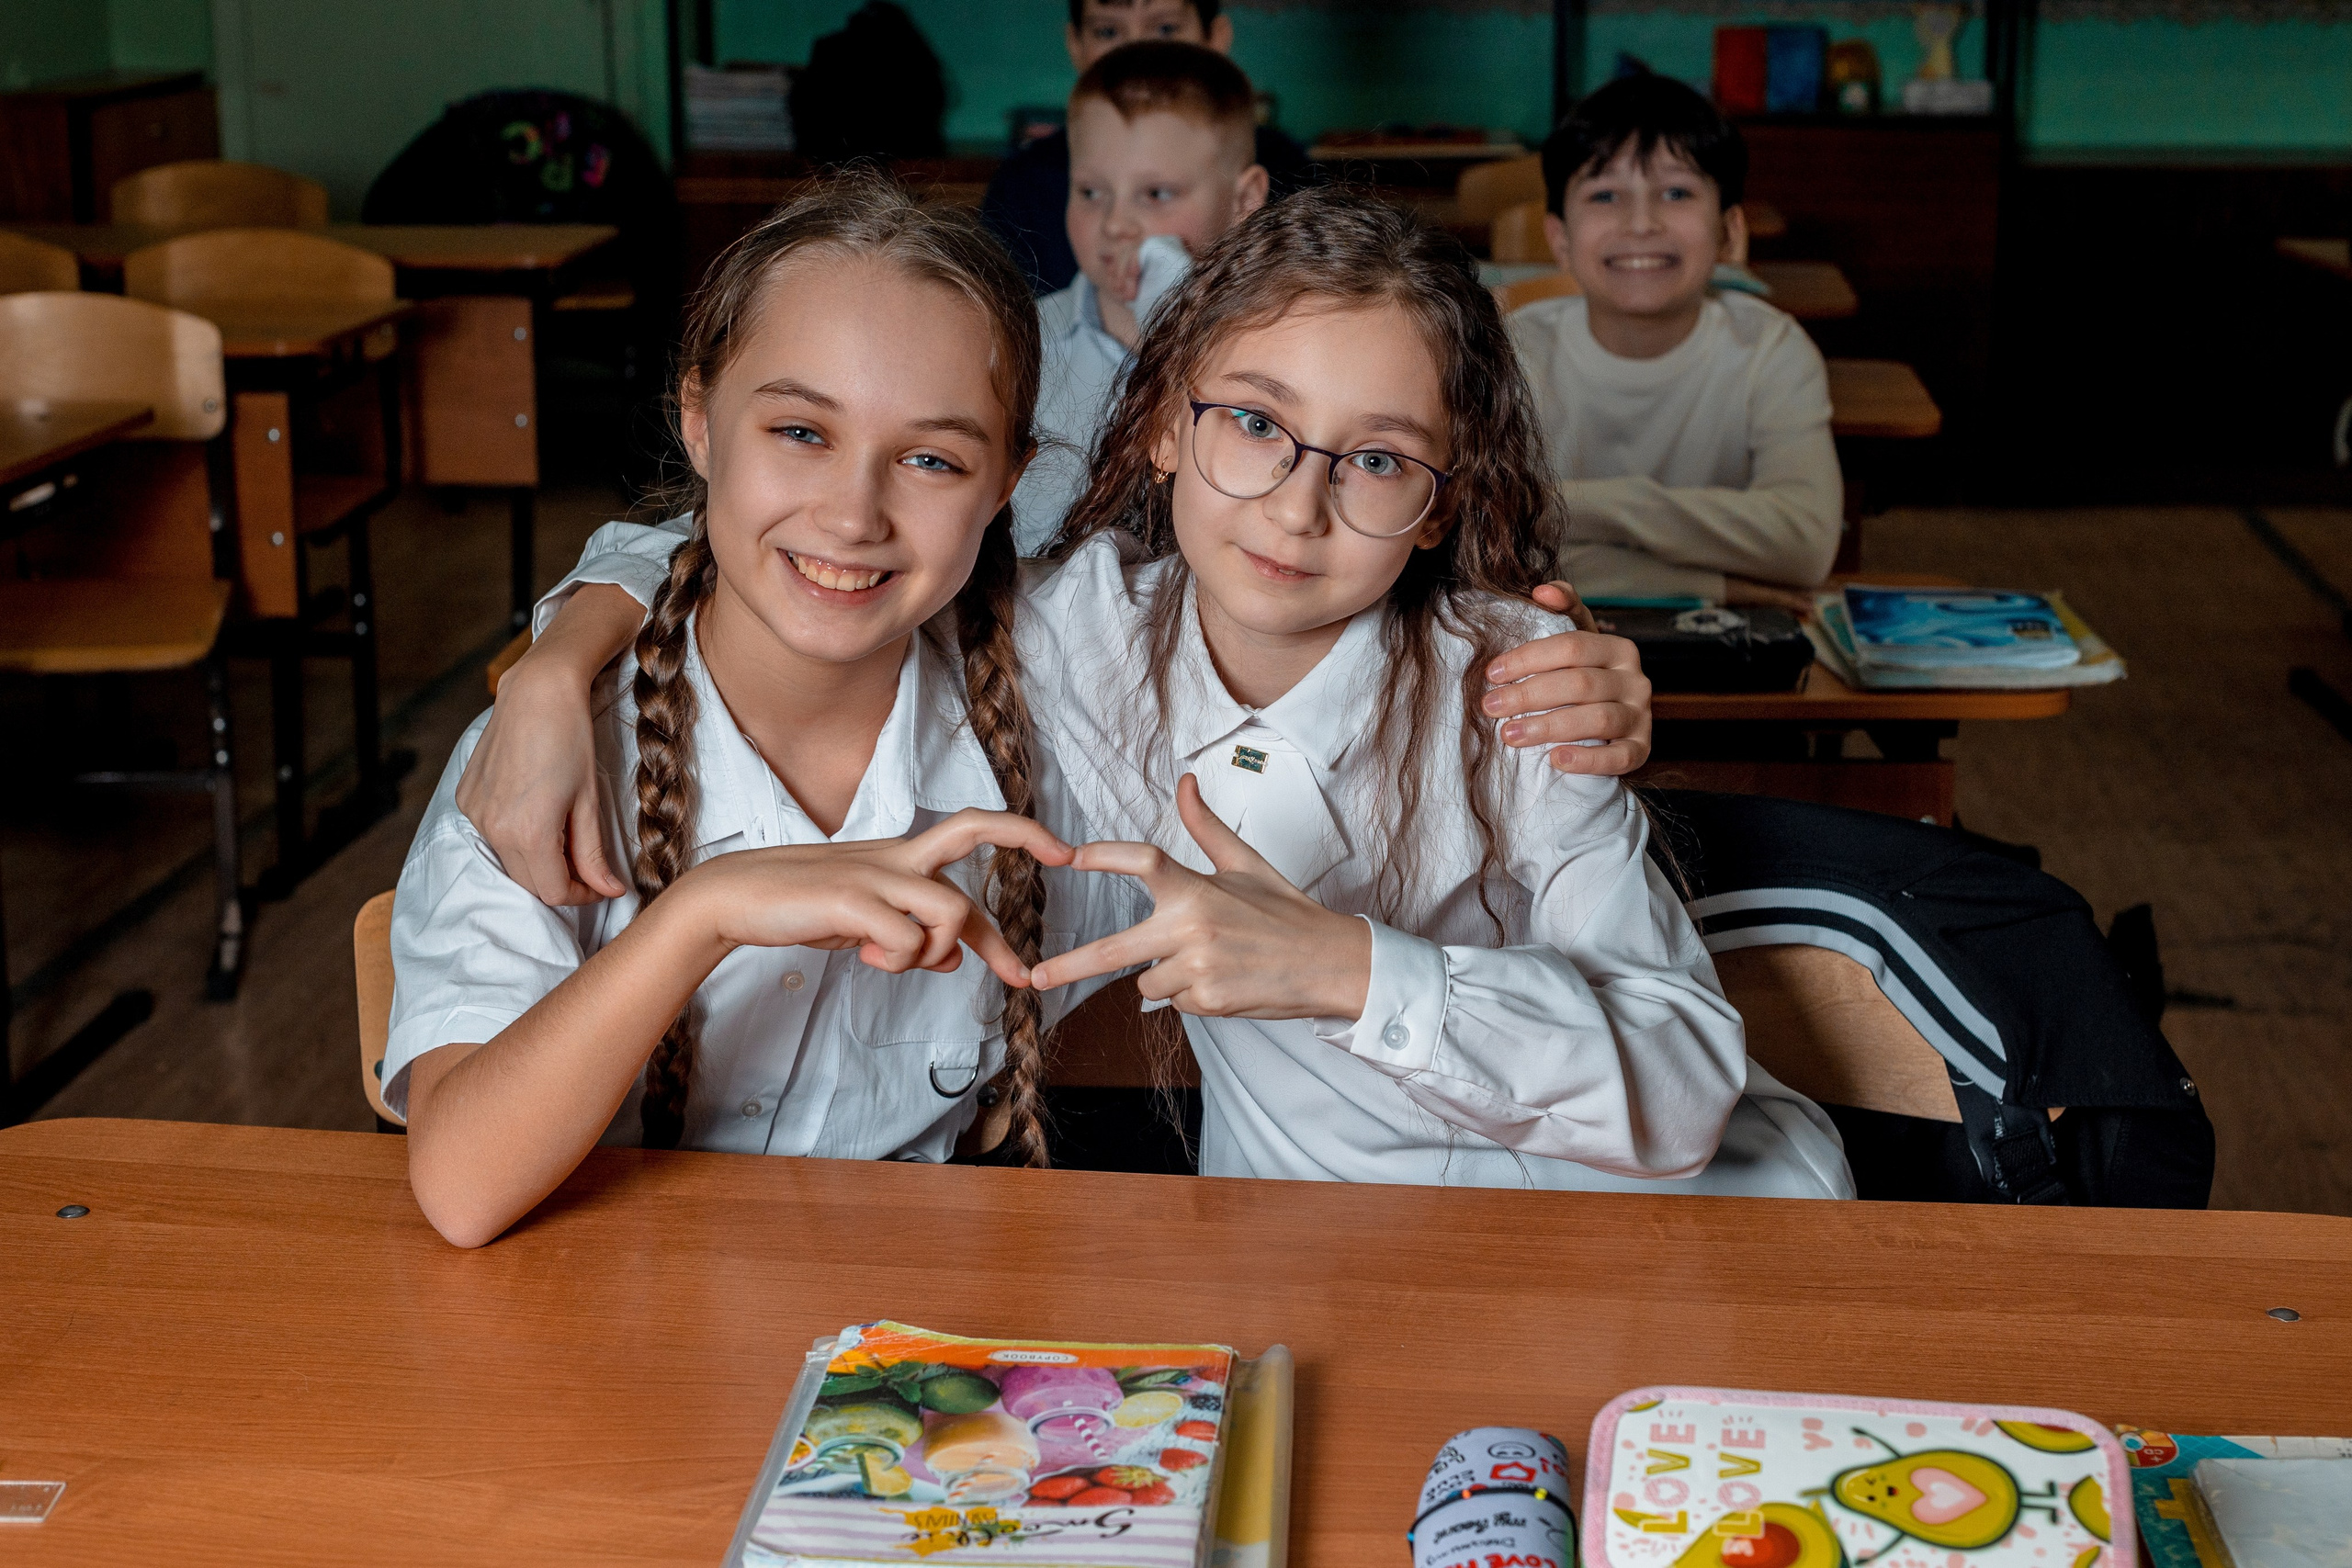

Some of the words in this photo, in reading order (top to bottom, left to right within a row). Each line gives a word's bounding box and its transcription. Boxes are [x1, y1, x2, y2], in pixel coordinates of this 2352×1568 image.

[1002, 1353, 1069, 1361] COPYBOOK
[1639, 1423, 1696, 1535] LOVE
[1712, 1427, 1766, 1540] LOVE
